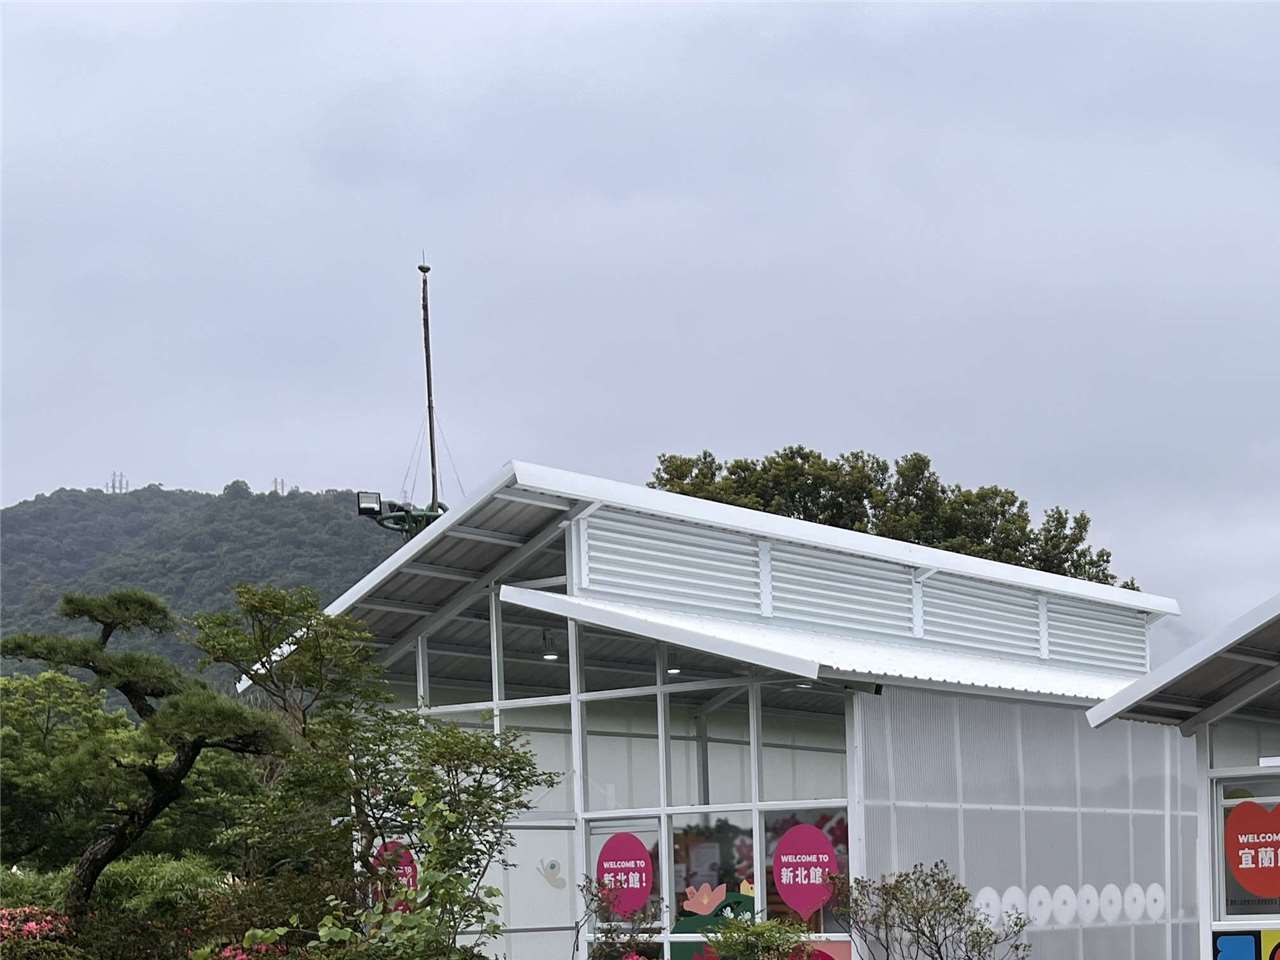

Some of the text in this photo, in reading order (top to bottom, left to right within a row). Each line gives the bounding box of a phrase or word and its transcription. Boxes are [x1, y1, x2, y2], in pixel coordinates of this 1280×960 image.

[781, 854, 829, 863] WELCOME TO
[603, 860, 646, 868] WELCOME TO
